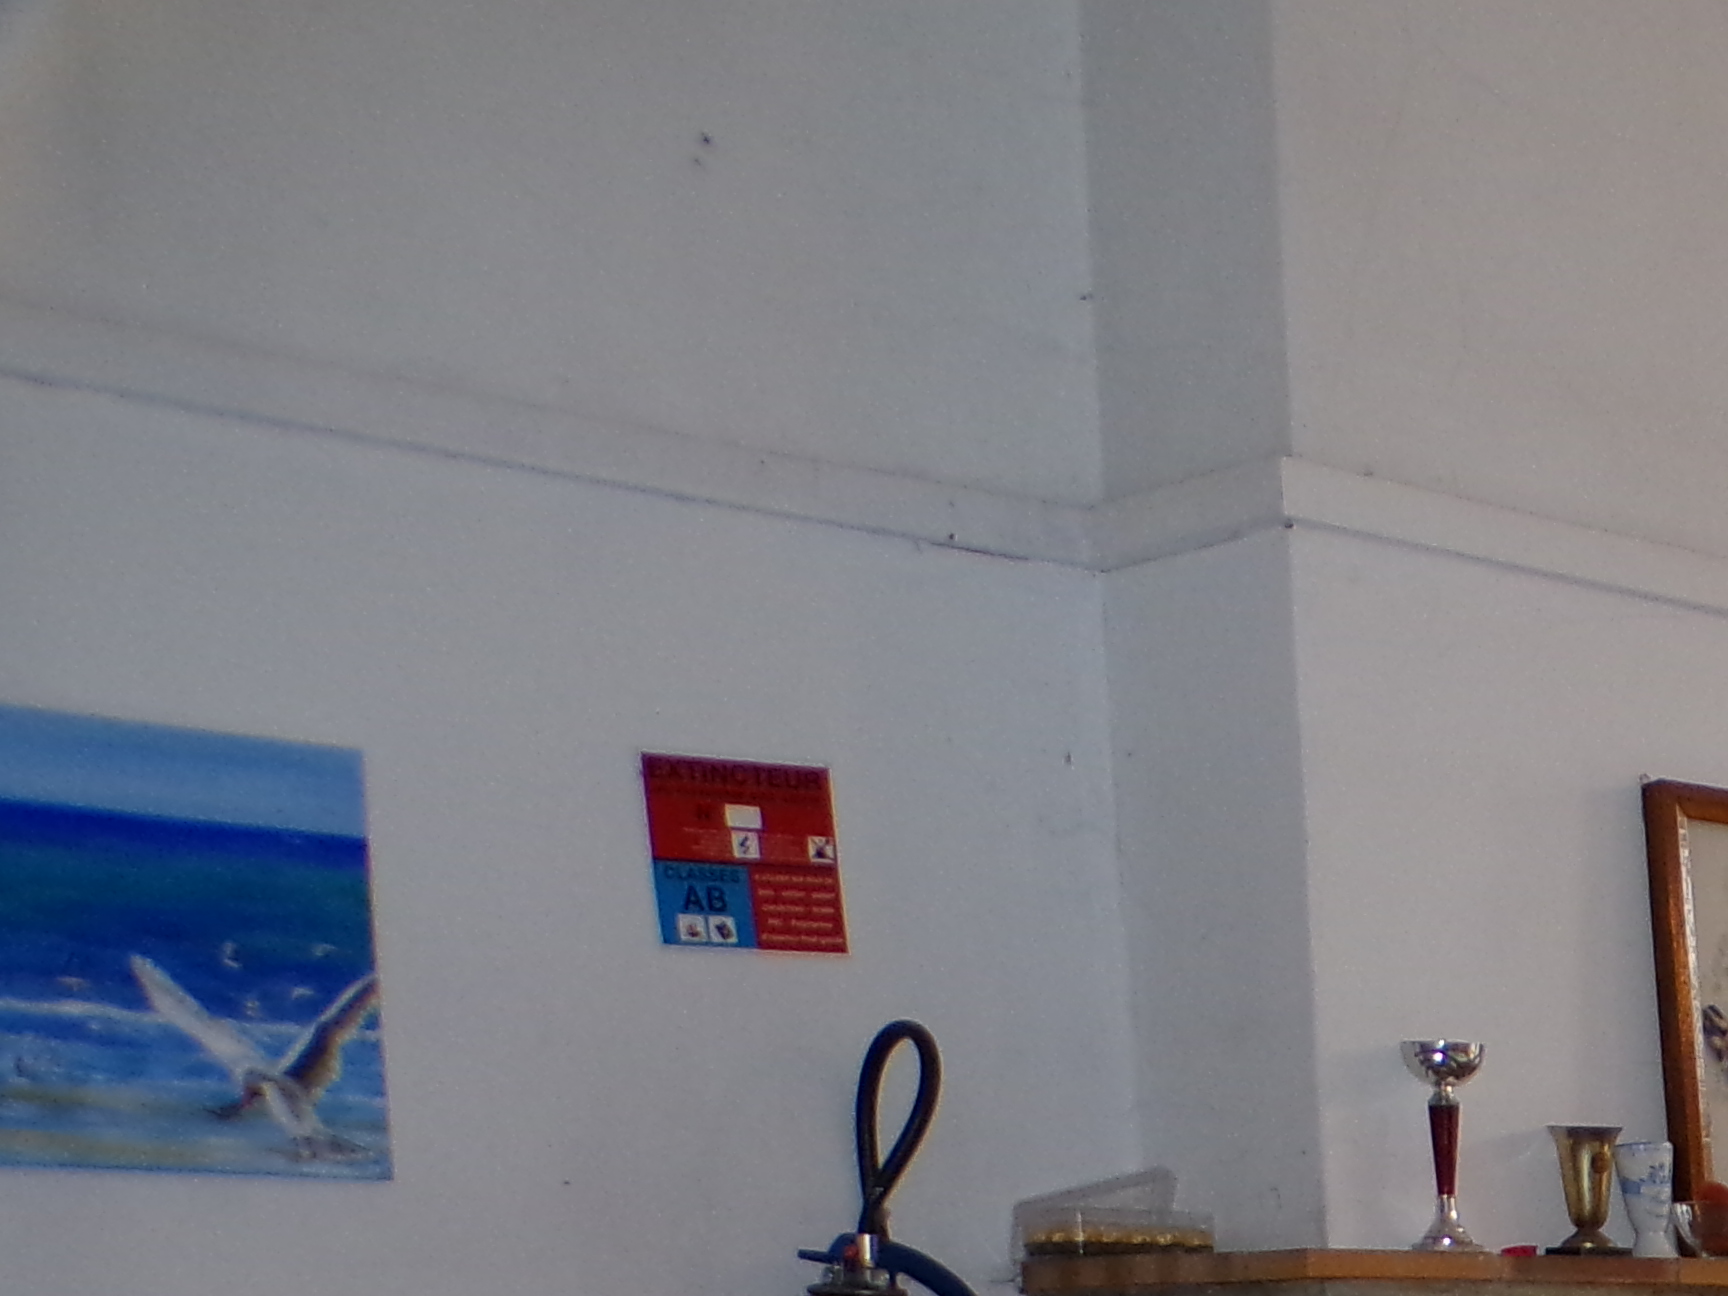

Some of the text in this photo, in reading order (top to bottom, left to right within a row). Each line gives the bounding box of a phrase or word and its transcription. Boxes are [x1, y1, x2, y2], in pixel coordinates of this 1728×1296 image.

[649, 761, 822, 789] EXTINCTEUR
[664, 865, 741, 884] CLASSES
[683, 884, 728, 912] AB
